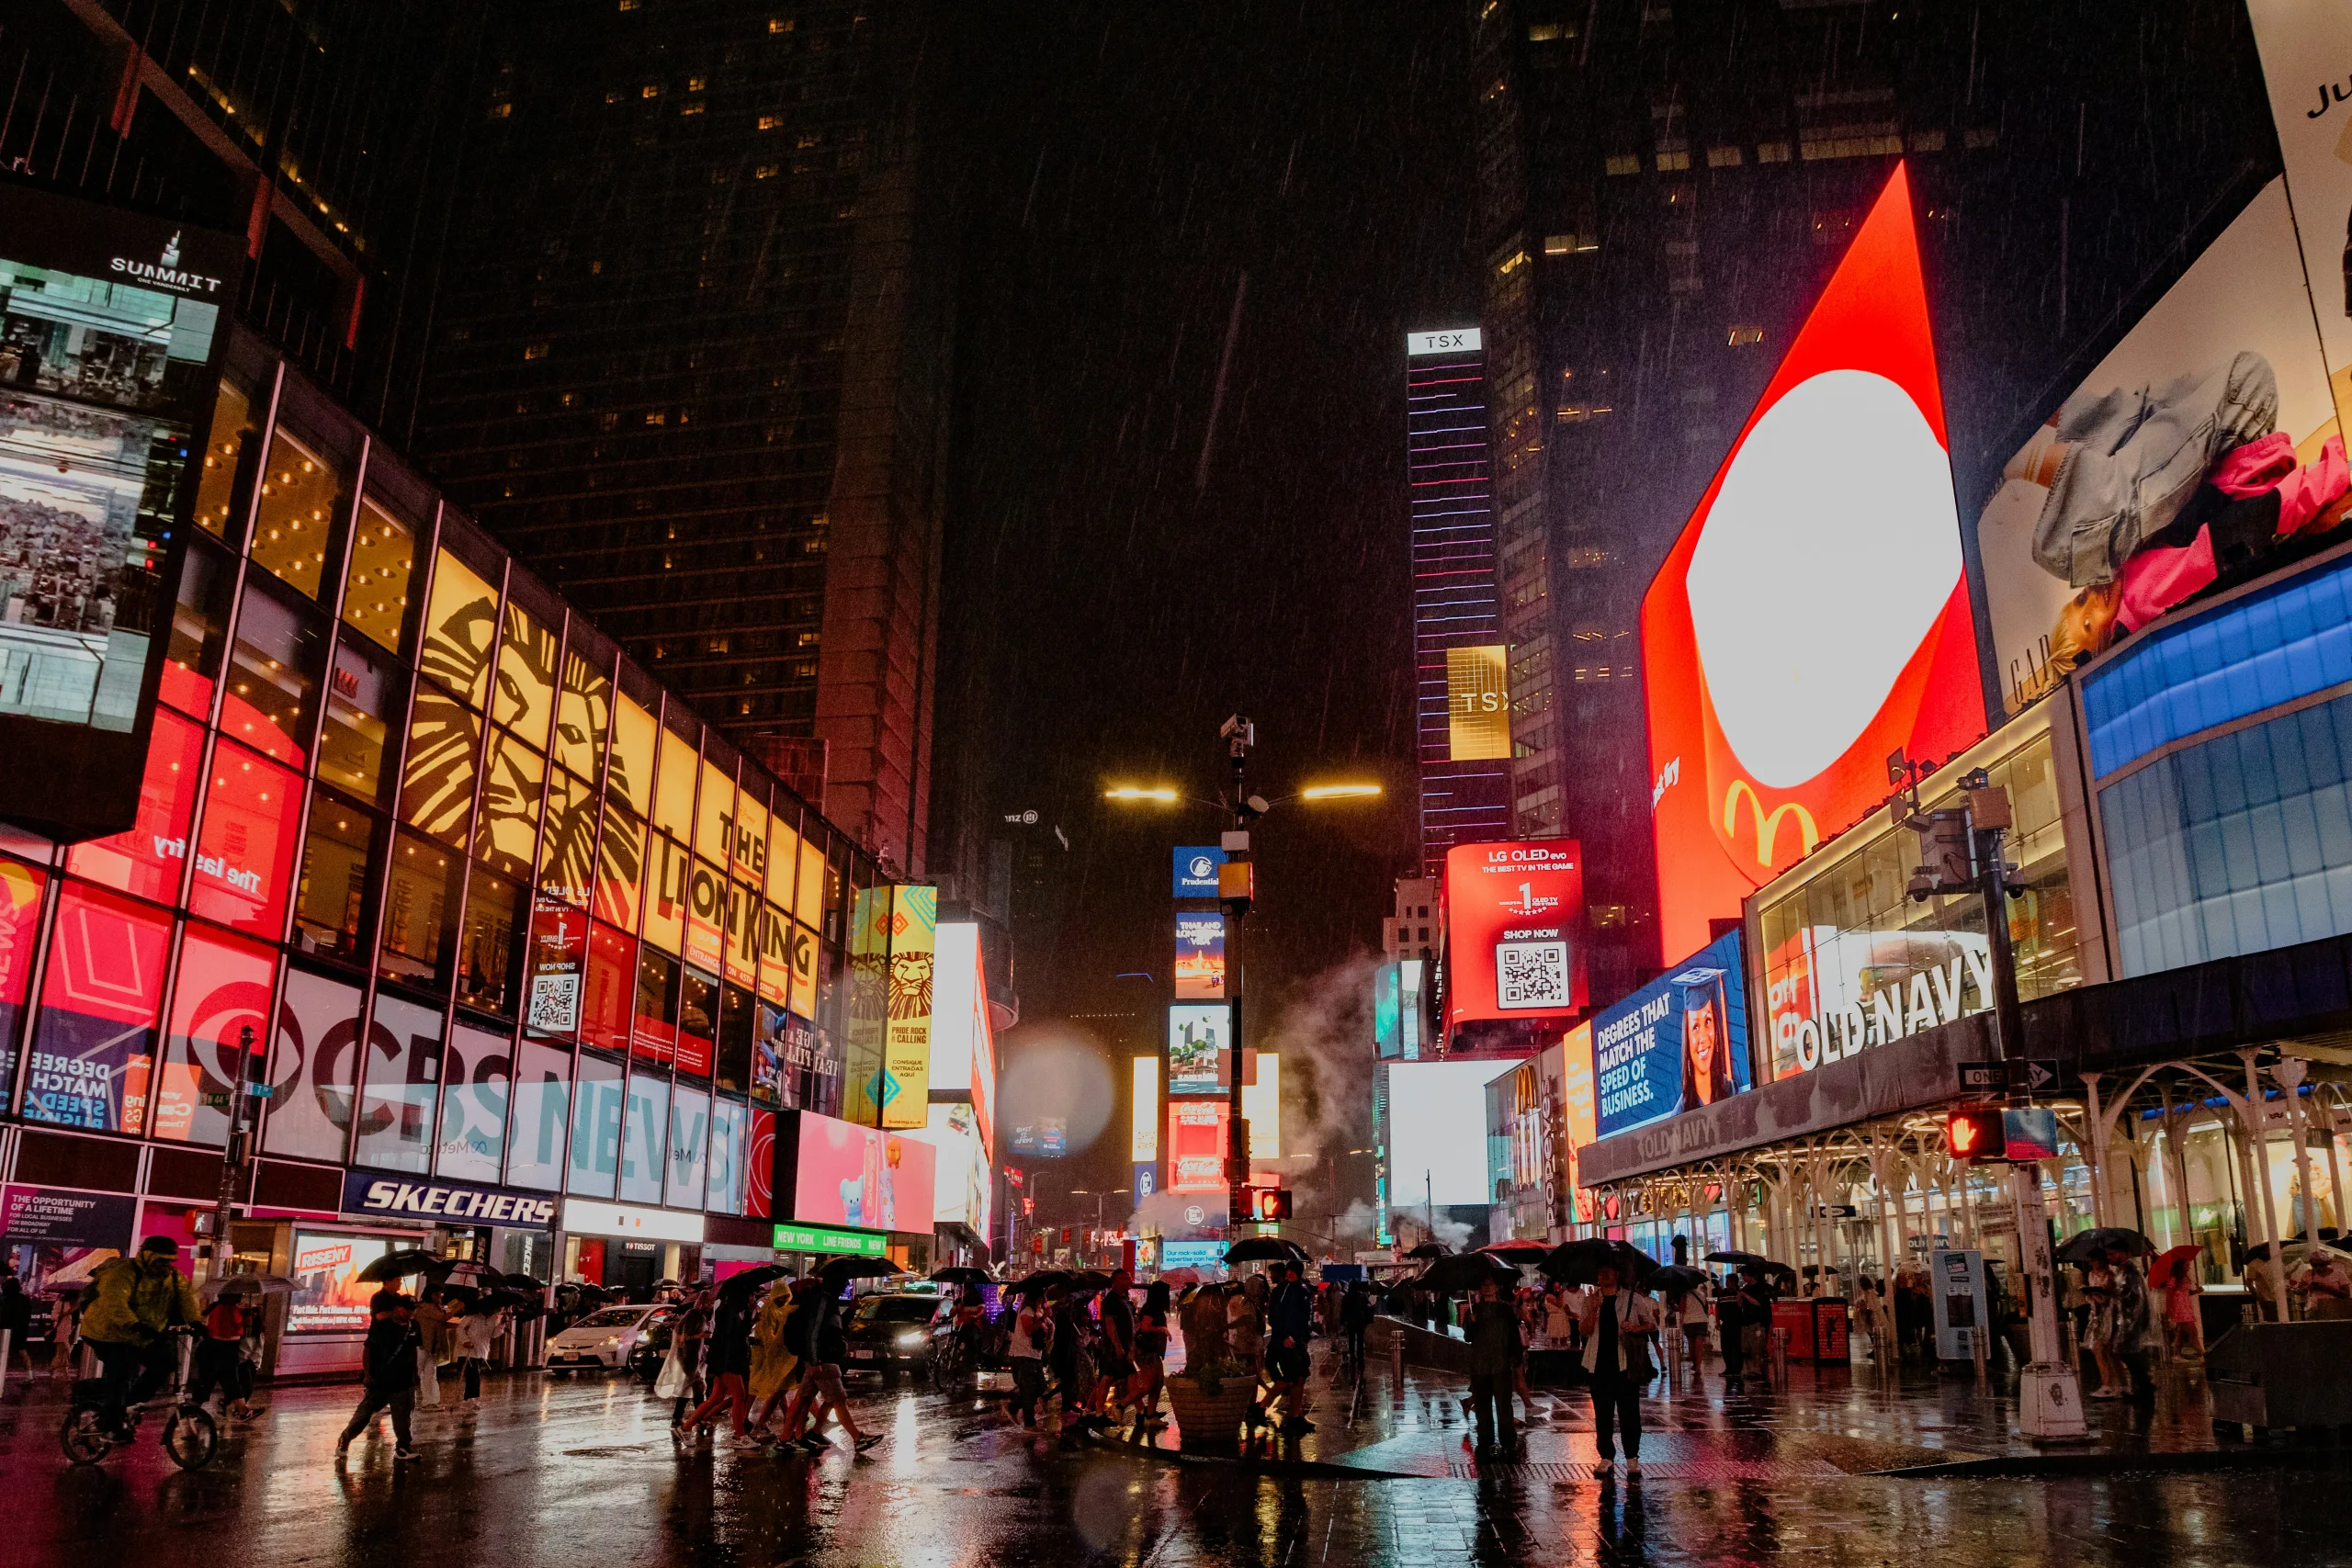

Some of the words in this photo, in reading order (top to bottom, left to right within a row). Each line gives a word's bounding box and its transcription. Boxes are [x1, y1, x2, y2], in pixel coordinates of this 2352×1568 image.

[111, 258, 221, 291] SUMMIT
[1426, 334, 1464, 349] TSX
[2010, 634, 2051, 705] GAP
[719, 811, 764, 871] THE
[1489, 851, 1507, 862] LG
[1511, 849, 1549, 861] OLED
[659, 825, 737, 936] LION
[741, 883, 810, 976] KING
[1504, 930, 1532, 939] SHOP
[1534, 929, 1558, 938] NOW
[690, 947, 720, 968] ENTRANCE
[727, 966, 737, 976] ON
[739, 972, 753, 985] 45TH
[759, 982, 775, 996] STREET
[1598, 1010, 1640, 1051] DEGREES
[1642, 993, 1670, 1027] THAT
[1797, 1002, 1867, 1071] OLD
[1874, 946, 1995, 1046] NAVY
[897, 1035, 926, 1044] CALLING
[1599, 1038, 1634, 1073] MATCH
[1634, 1027, 1655, 1055] THE
[1601, 1065, 1629, 1095] SPEED
[1631, 1057, 1646, 1081] OF
[1973, 1071, 2001, 1083] ONE
[2029, 1070, 2043, 1082] AY
[312, 1017, 522, 1159] CBS
[537, 1069, 732, 1192] NEWS
[1602, 1080, 1653, 1117] BUSINESS.
[1645, 1130, 1669, 1157] OLD
[1672, 1119, 1710, 1154] NAVY
[12, 1195, 31, 1203] THE
[32, 1197, 96, 1208] OPPORTUNITY
[33, 1205, 74, 1215] LIFETIME
[364, 1181, 554, 1223] SKECHERS
[302, 1247, 349, 1268] RISENY
[523, 1235, 533, 1276] SKEC
[634, 1243, 655, 1251] TISSOT
[777, 1231, 795, 1243] NEW
[796, 1232, 814, 1245] YORK
[823, 1236, 837, 1247] LINE
[838, 1237, 861, 1249] FRIENDS
[868, 1240, 881, 1250] NEW
[1909, 1239, 1926, 1248] OLD
